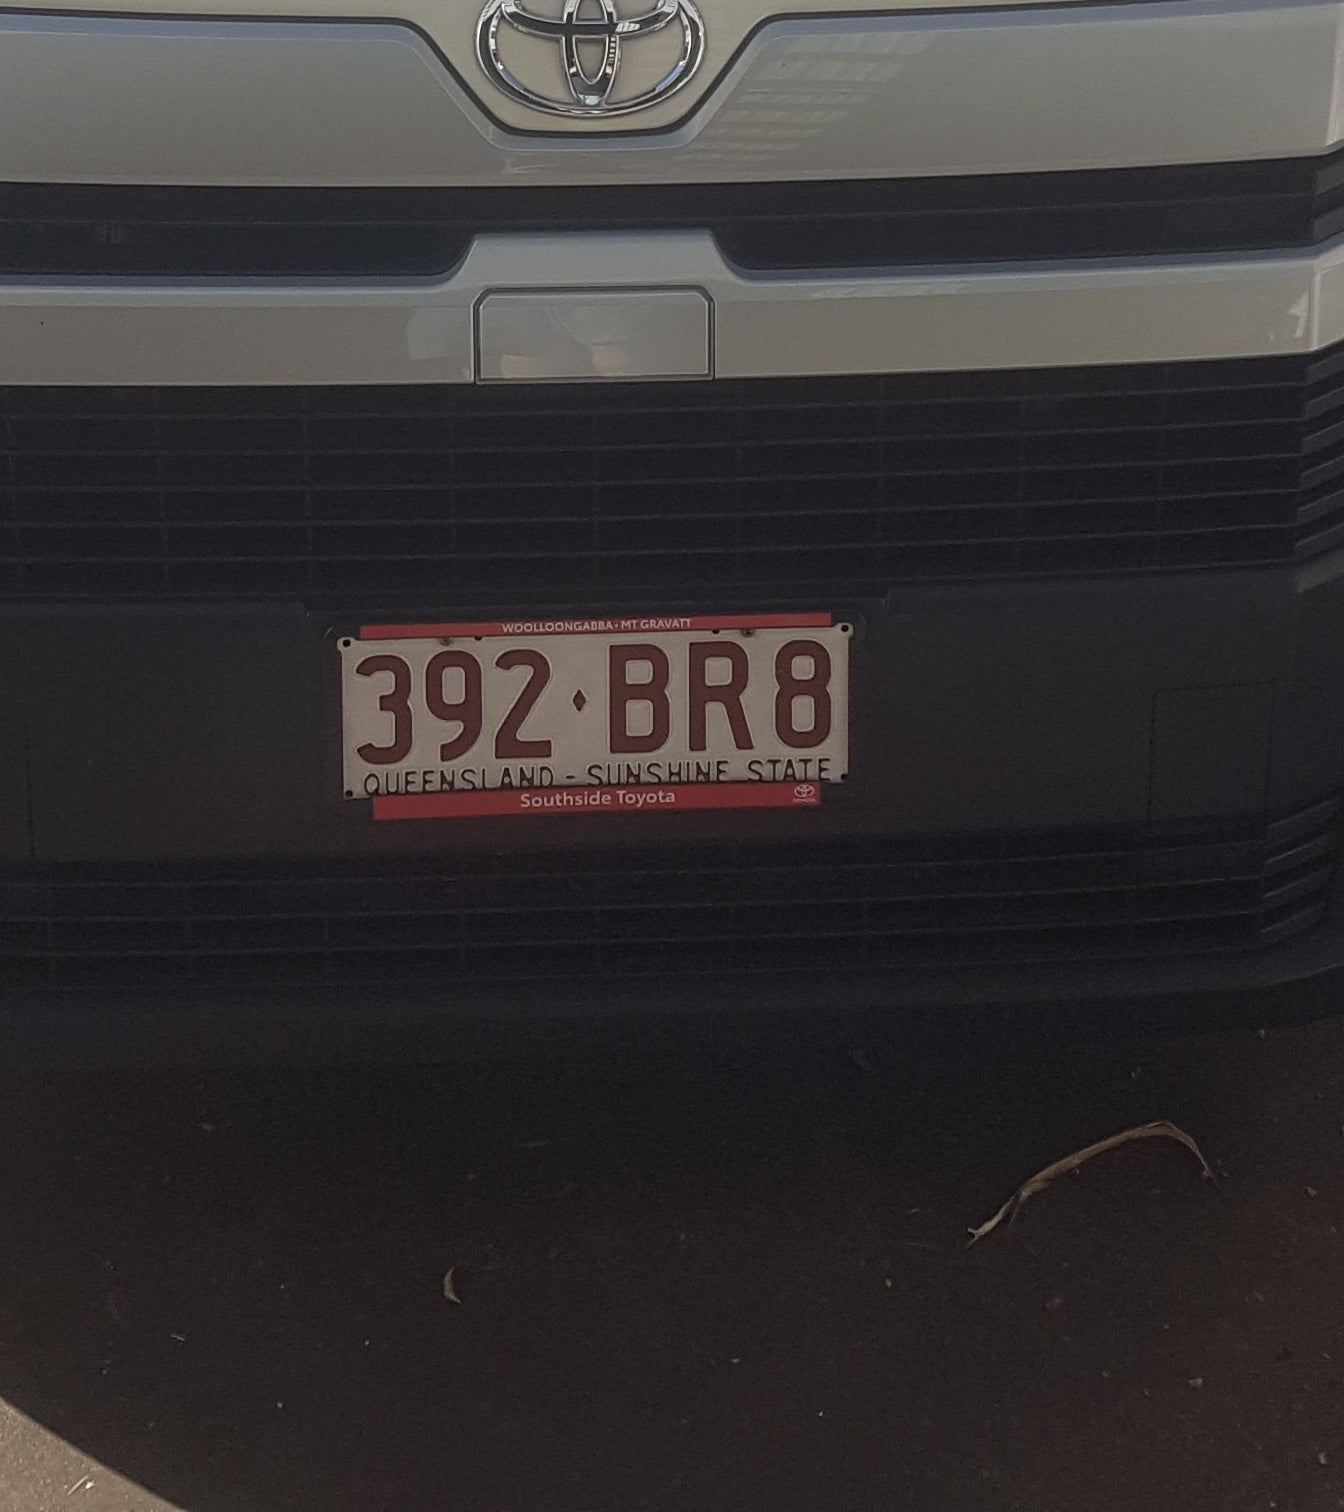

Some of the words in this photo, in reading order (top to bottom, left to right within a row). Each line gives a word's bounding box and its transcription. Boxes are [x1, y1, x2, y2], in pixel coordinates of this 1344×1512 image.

[502, 621, 613, 633] WOOLLOONGABBA
[621, 620, 637, 630] MT
[640, 618, 692, 630] GRAVATT
[355, 648, 553, 765] 392
[608, 639, 832, 754] BR8
[363, 765, 555, 796] QUEENSLAND
[587, 759, 730, 788] SUNSHINE
[747, 757, 833, 784] STATE
[519, 789, 612, 809] Southside
[615, 789, 676, 809] Toyota
